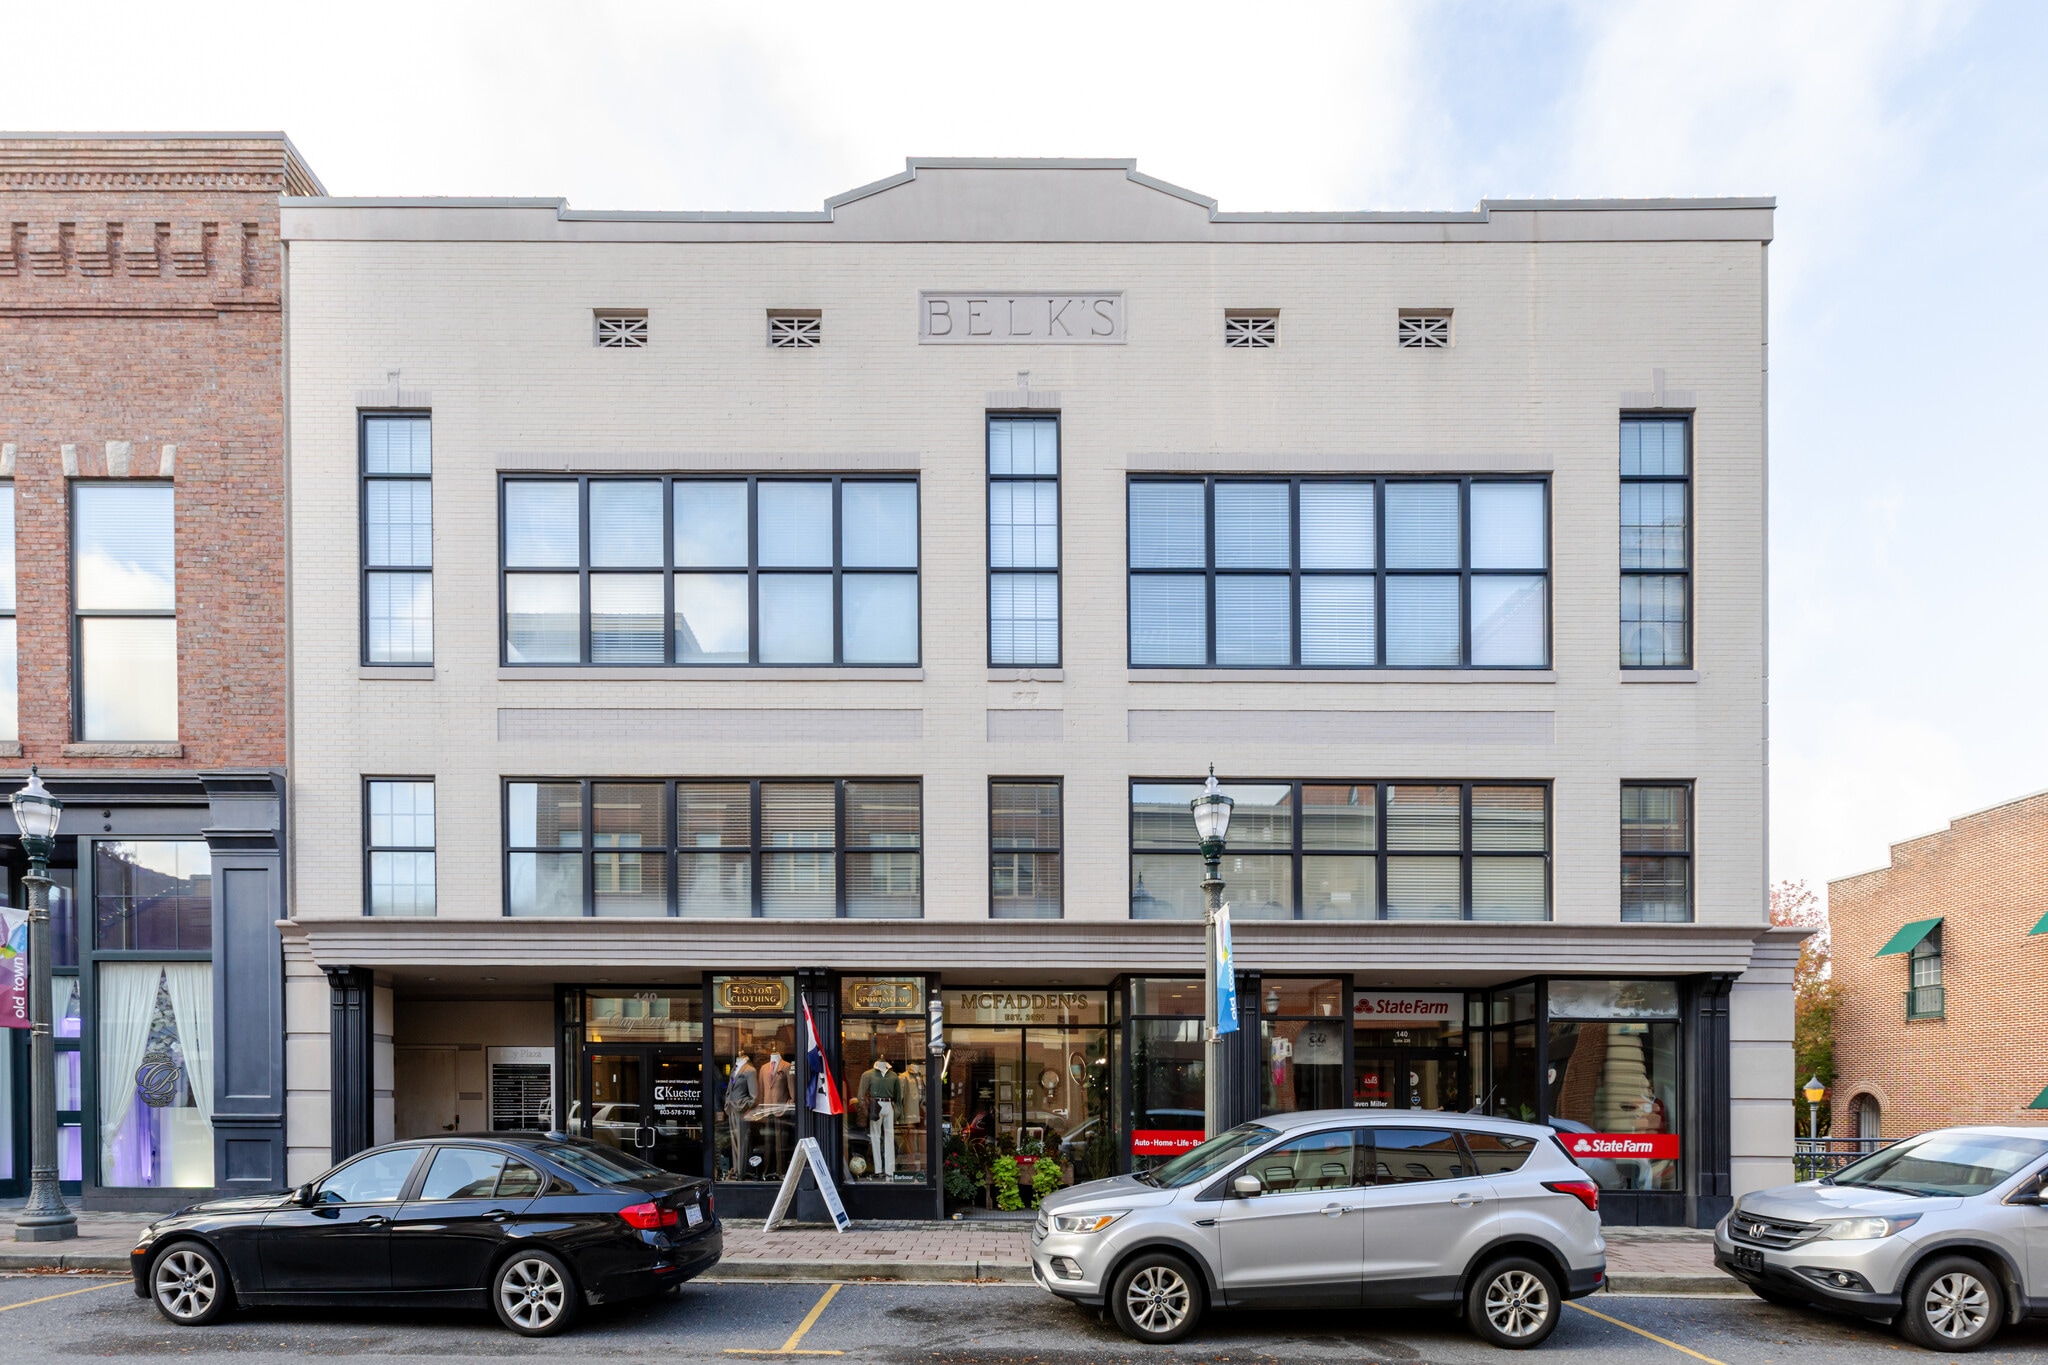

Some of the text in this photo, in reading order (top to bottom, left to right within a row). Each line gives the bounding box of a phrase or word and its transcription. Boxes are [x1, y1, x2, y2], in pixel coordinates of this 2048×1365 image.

[927, 299, 1115, 337] BELK'S
[12, 956, 25, 1019] old town
[733, 987, 773, 995] CUSTOM
[1227, 954, 1238, 1021] old town
[633, 992, 658, 1003] 140
[730, 995, 777, 1003] CLOTHING
[858, 996, 908, 1004] SPORTSWEAR
[961, 993, 1089, 1010] MCFADDEN'S
[604, 1009, 637, 1034] City
[1004, 1013, 1023, 1021] EST.
[1395, 1030, 1409, 1038] 140
[520, 1048, 542, 1058] Plaza
[665, 1086, 701, 1098] Kuester
[1370, 1100, 1388, 1108] Miller
[1134, 1138, 1150, 1147] Auto
[1153, 1139, 1173, 1147] Home
[1176, 1139, 1190, 1147] Life
